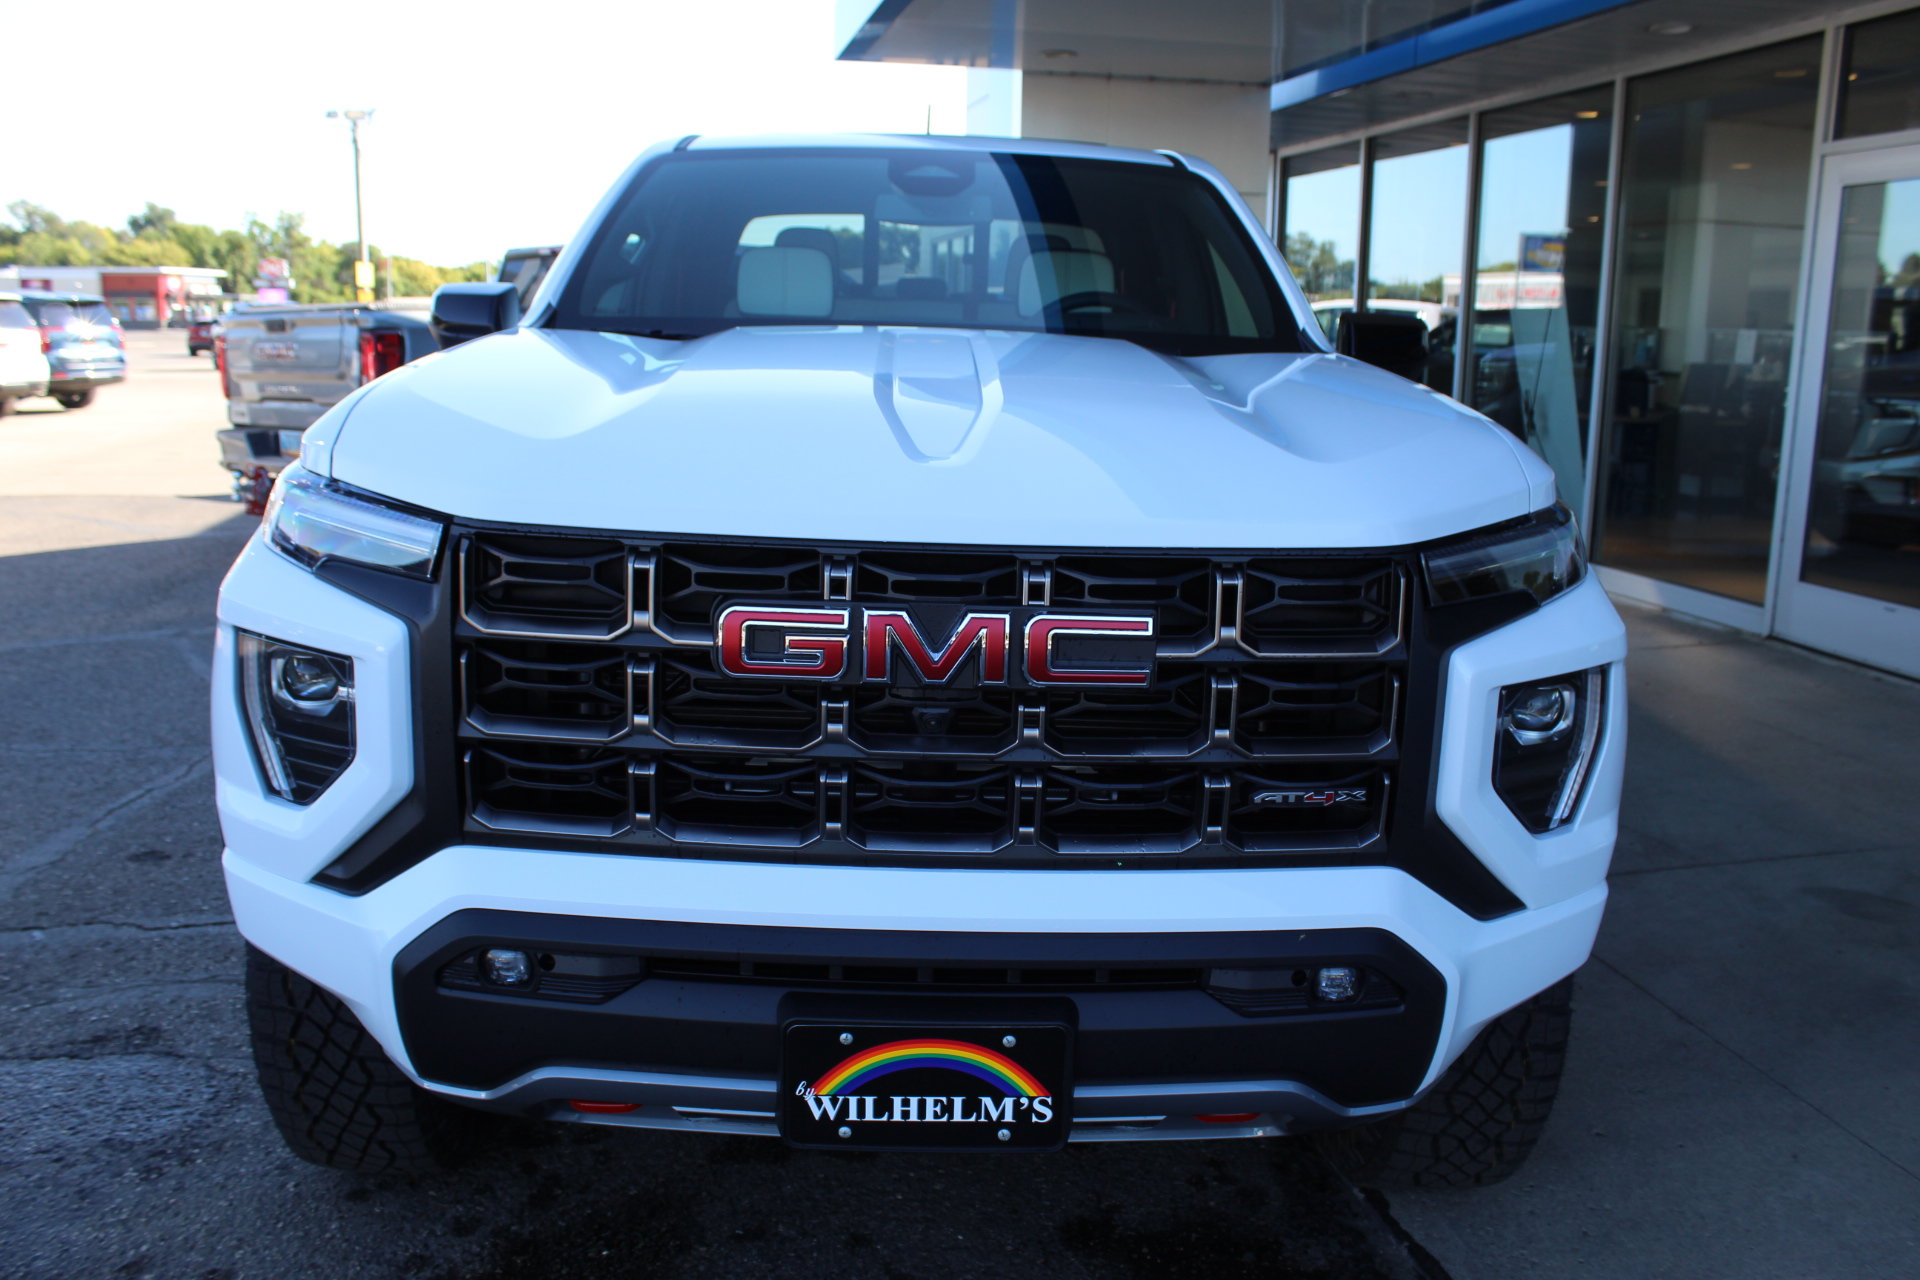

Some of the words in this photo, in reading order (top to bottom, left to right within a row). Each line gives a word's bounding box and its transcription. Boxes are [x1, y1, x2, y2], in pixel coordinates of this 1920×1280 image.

[717, 604, 1155, 687] GMC
[1253, 789, 1367, 807] AT4X
[795, 1080, 817, 1101] by
[802, 1094, 1054, 1123] WILHELM'S
